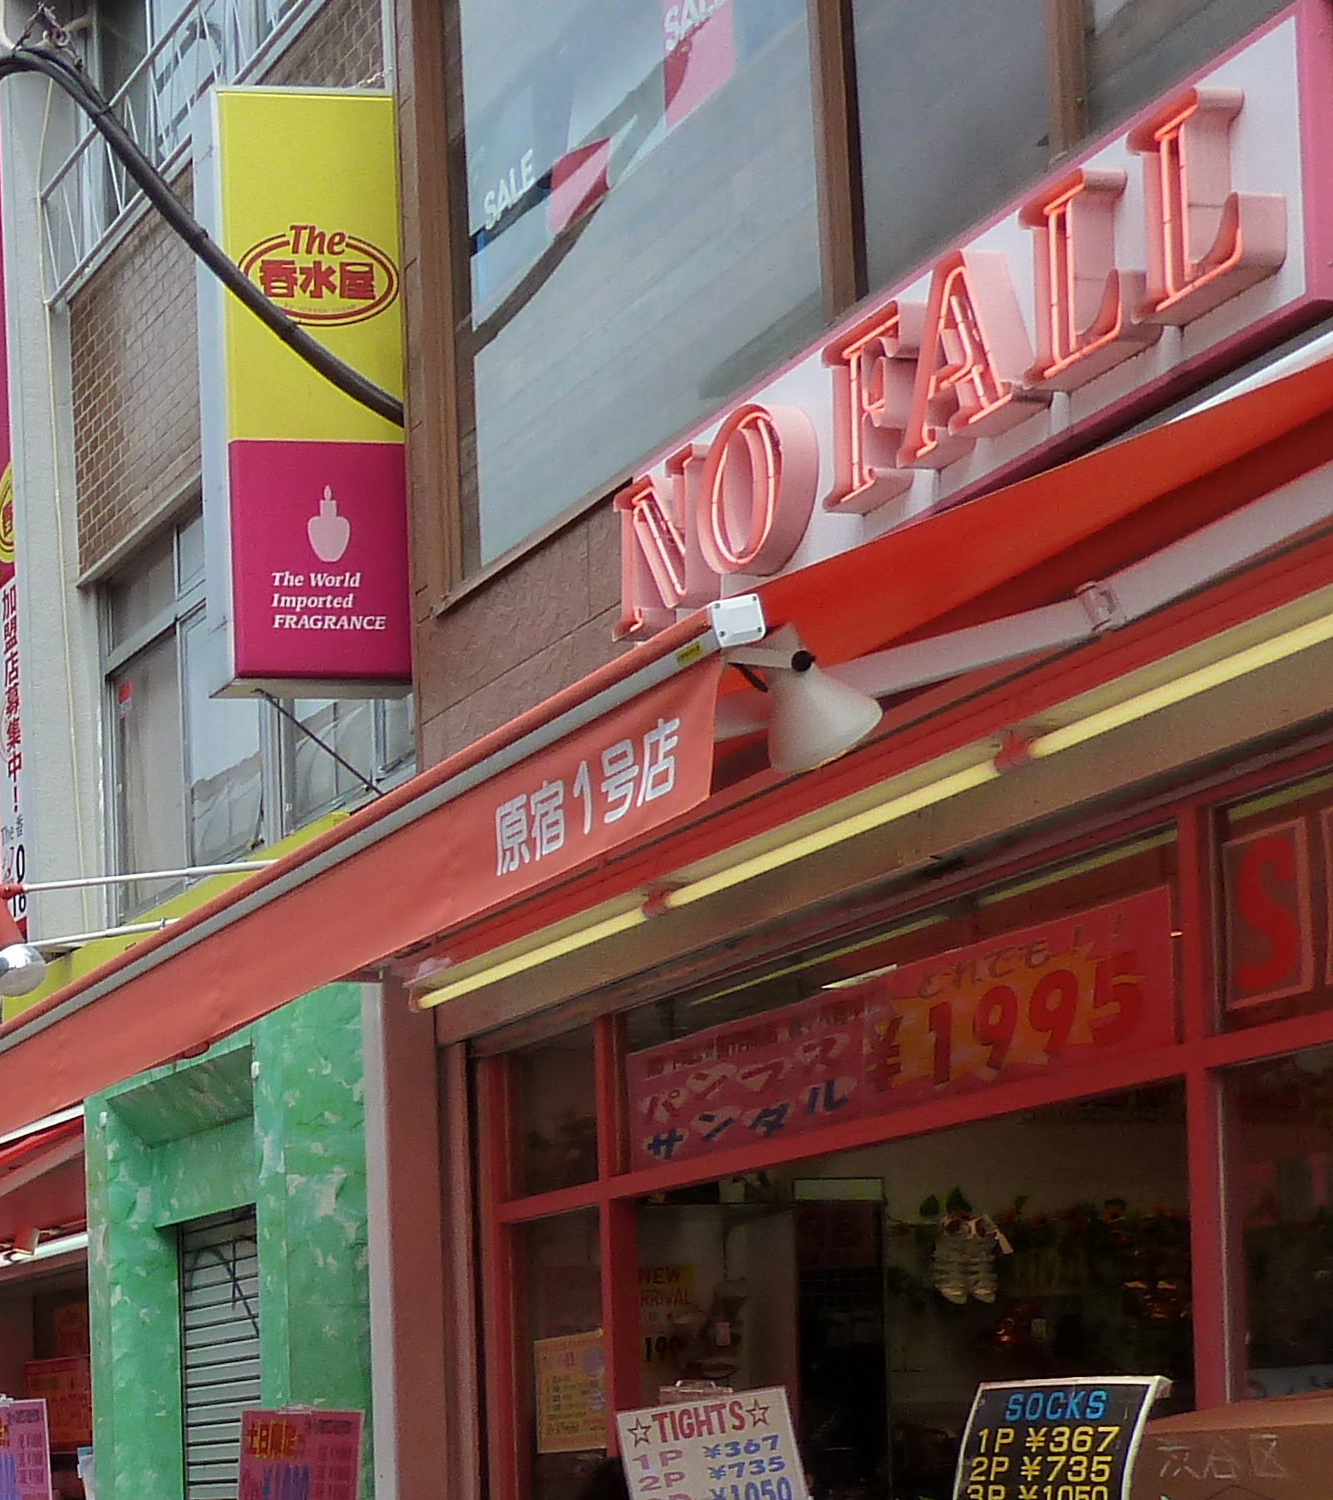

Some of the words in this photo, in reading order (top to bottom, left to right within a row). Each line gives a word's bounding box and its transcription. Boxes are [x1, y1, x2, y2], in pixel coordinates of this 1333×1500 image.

[484, 148, 536, 229] SALE
[289, 224, 347, 256] The
[260, 259, 376, 300] 香水屋
[612, 404, 820, 641] NO
[822, 86, 1287, 513] FALL
[271, 572, 305, 588] The
[309, 572, 361, 588] World
[272, 593, 353, 610] Imported
[274, 615, 387, 631] FRAGRANCE
[495, 716, 681, 876] 原宿1号店
[651, 1400, 746, 1444] TIGHTS
[1005, 1390, 1109, 1422] SOCKS
[701, 1434, 780, 1460] ¥367
[978, 1428, 1016, 1454] 1P
[1025, 1426, 1121, 1454] ¥367
[638, 1471, 686, 1493] 2P
[707, 1456, 786, 1481] ¥735
[969, 1456, 1011, 1482] 2P
[1020, 1455, 1114, 1483] ¥735
